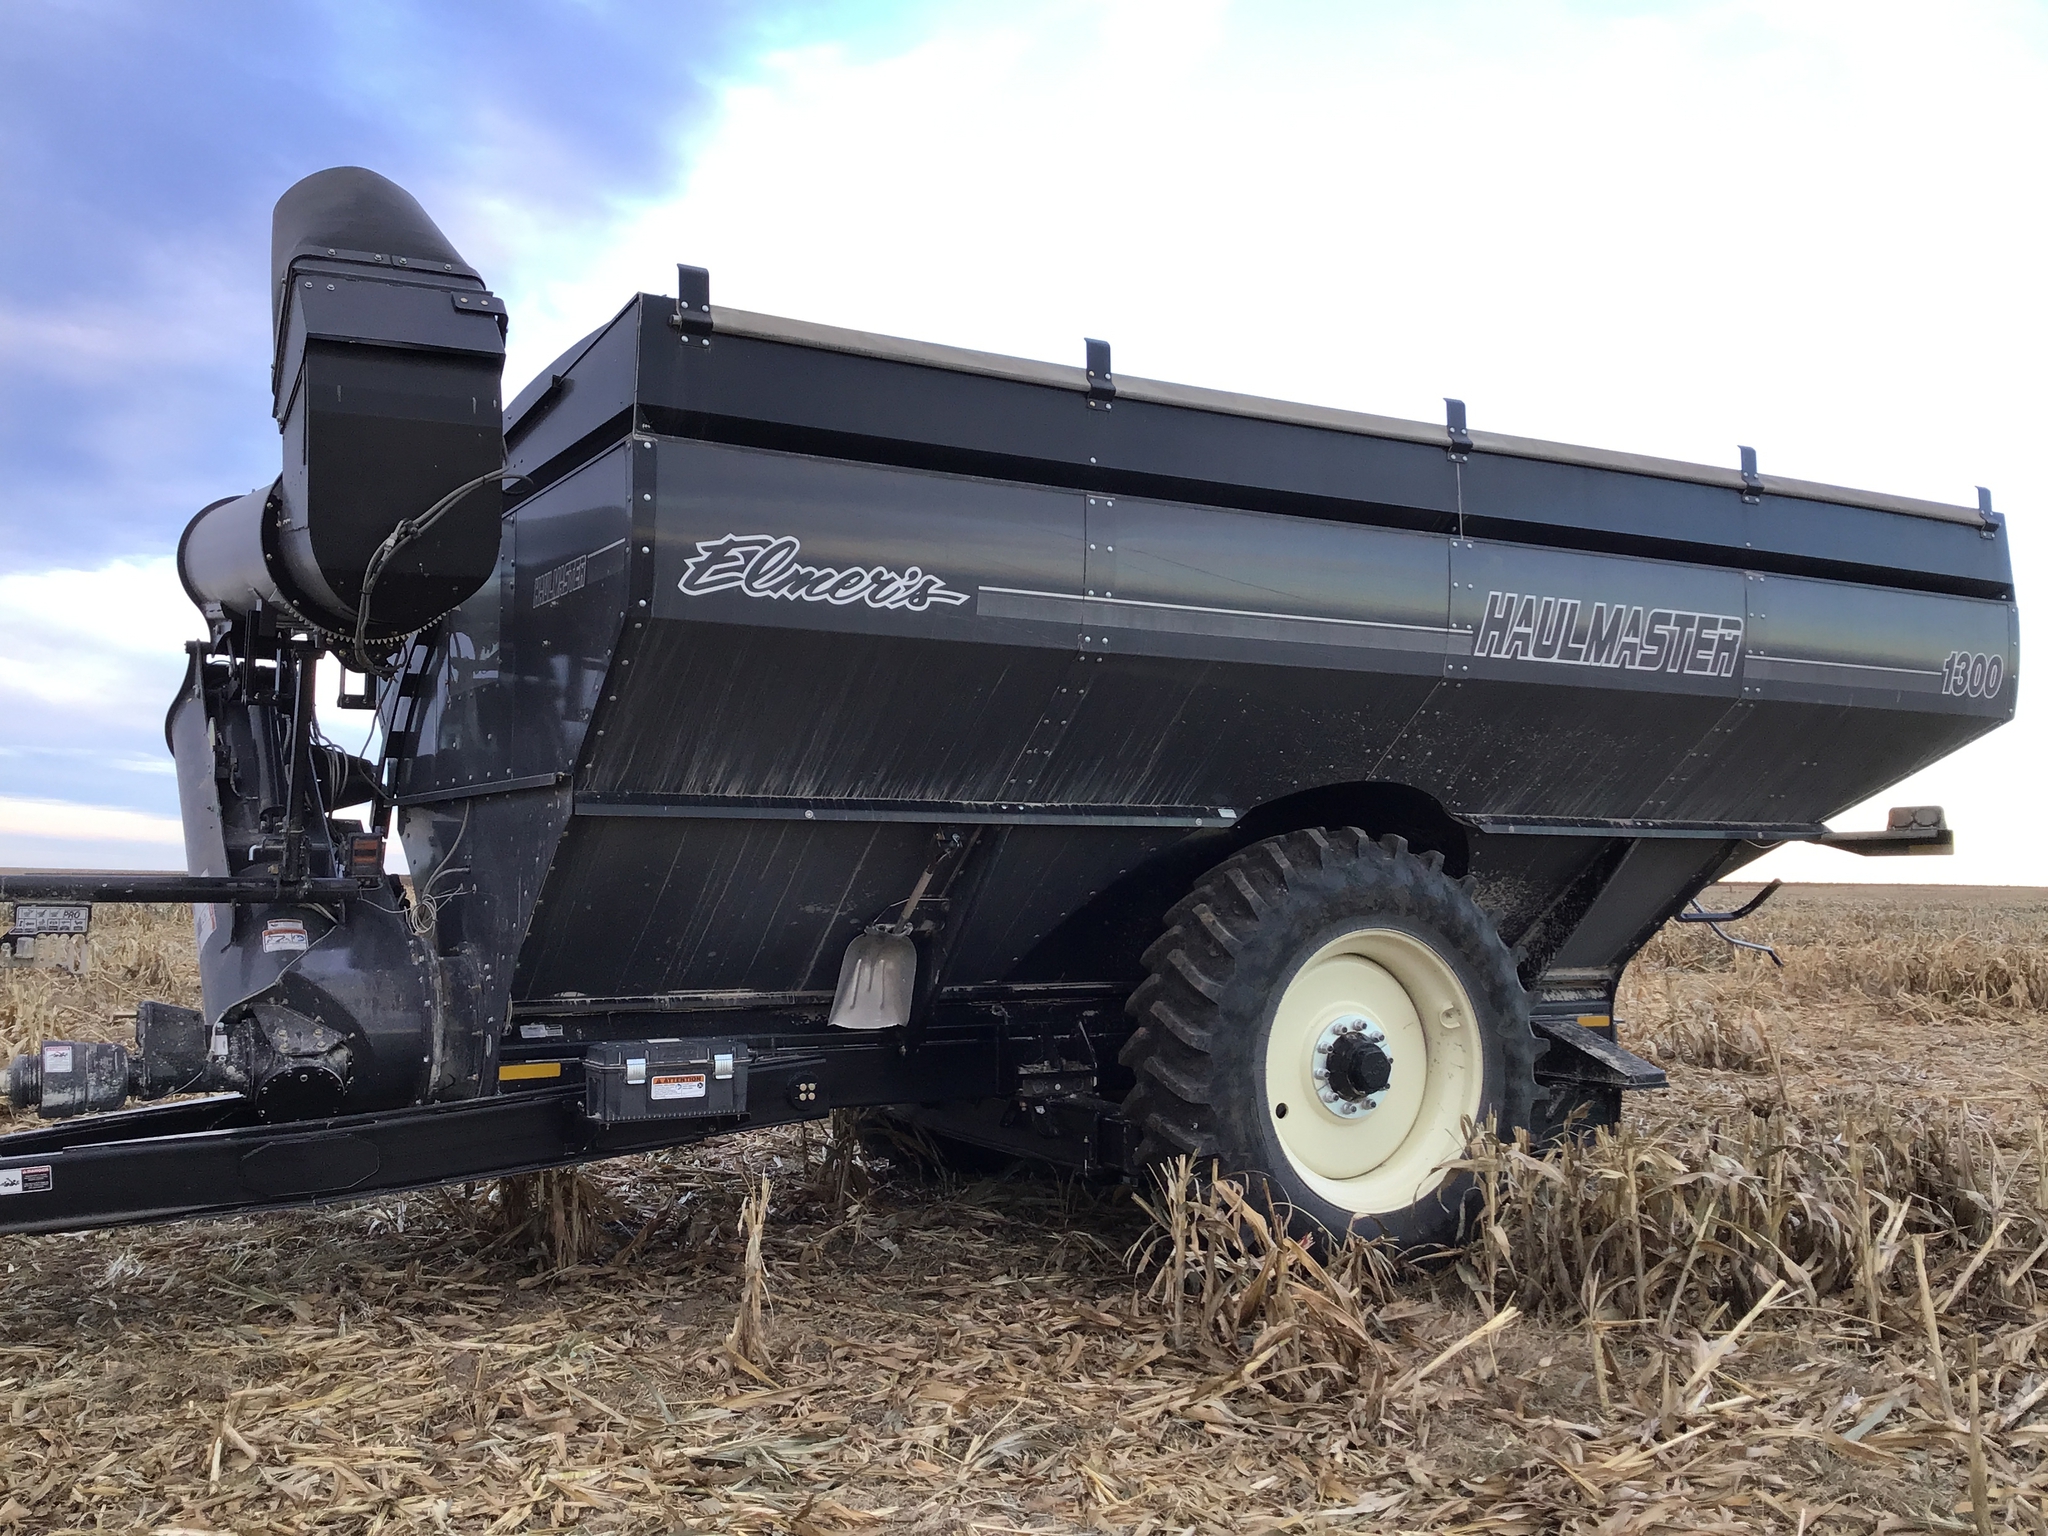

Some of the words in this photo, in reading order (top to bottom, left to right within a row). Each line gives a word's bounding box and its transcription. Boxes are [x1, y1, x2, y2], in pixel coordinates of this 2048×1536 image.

[678, 533, 970, 611] Elmer's
[1474, 591, 1745, 678] HAULMASTER
[1941, 650, 2004, 699] 1300
[63, 909, 81, 919] PRO
[664, 1076, 703, 1084] ATTENTION
